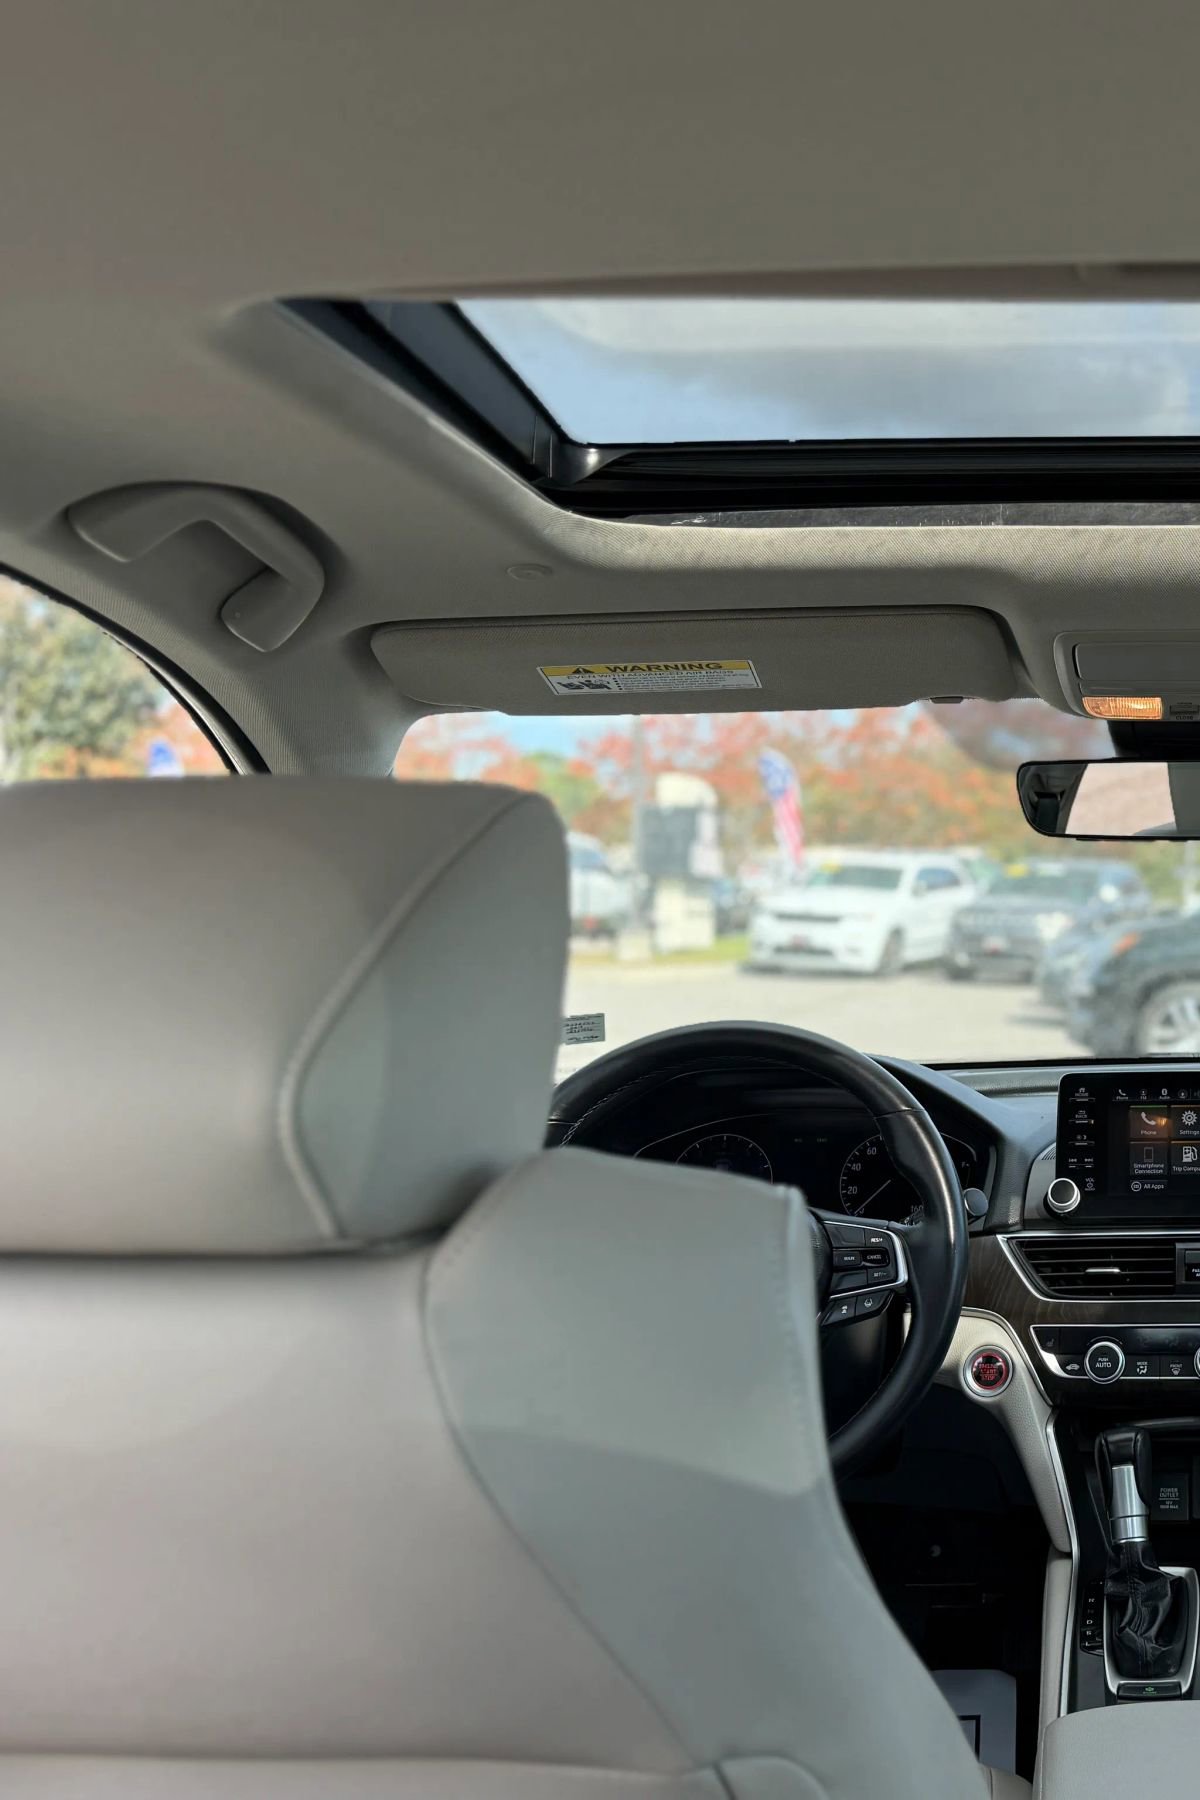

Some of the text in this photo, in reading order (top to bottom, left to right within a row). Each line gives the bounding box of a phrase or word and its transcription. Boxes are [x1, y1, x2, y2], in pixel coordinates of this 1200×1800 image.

[605, 662, 723, 673] WARNING
[866, 1147, 877, 1155] 60
[851, 1162, 861, 1171] 40
[847, 1186, 858, 1194] 20
